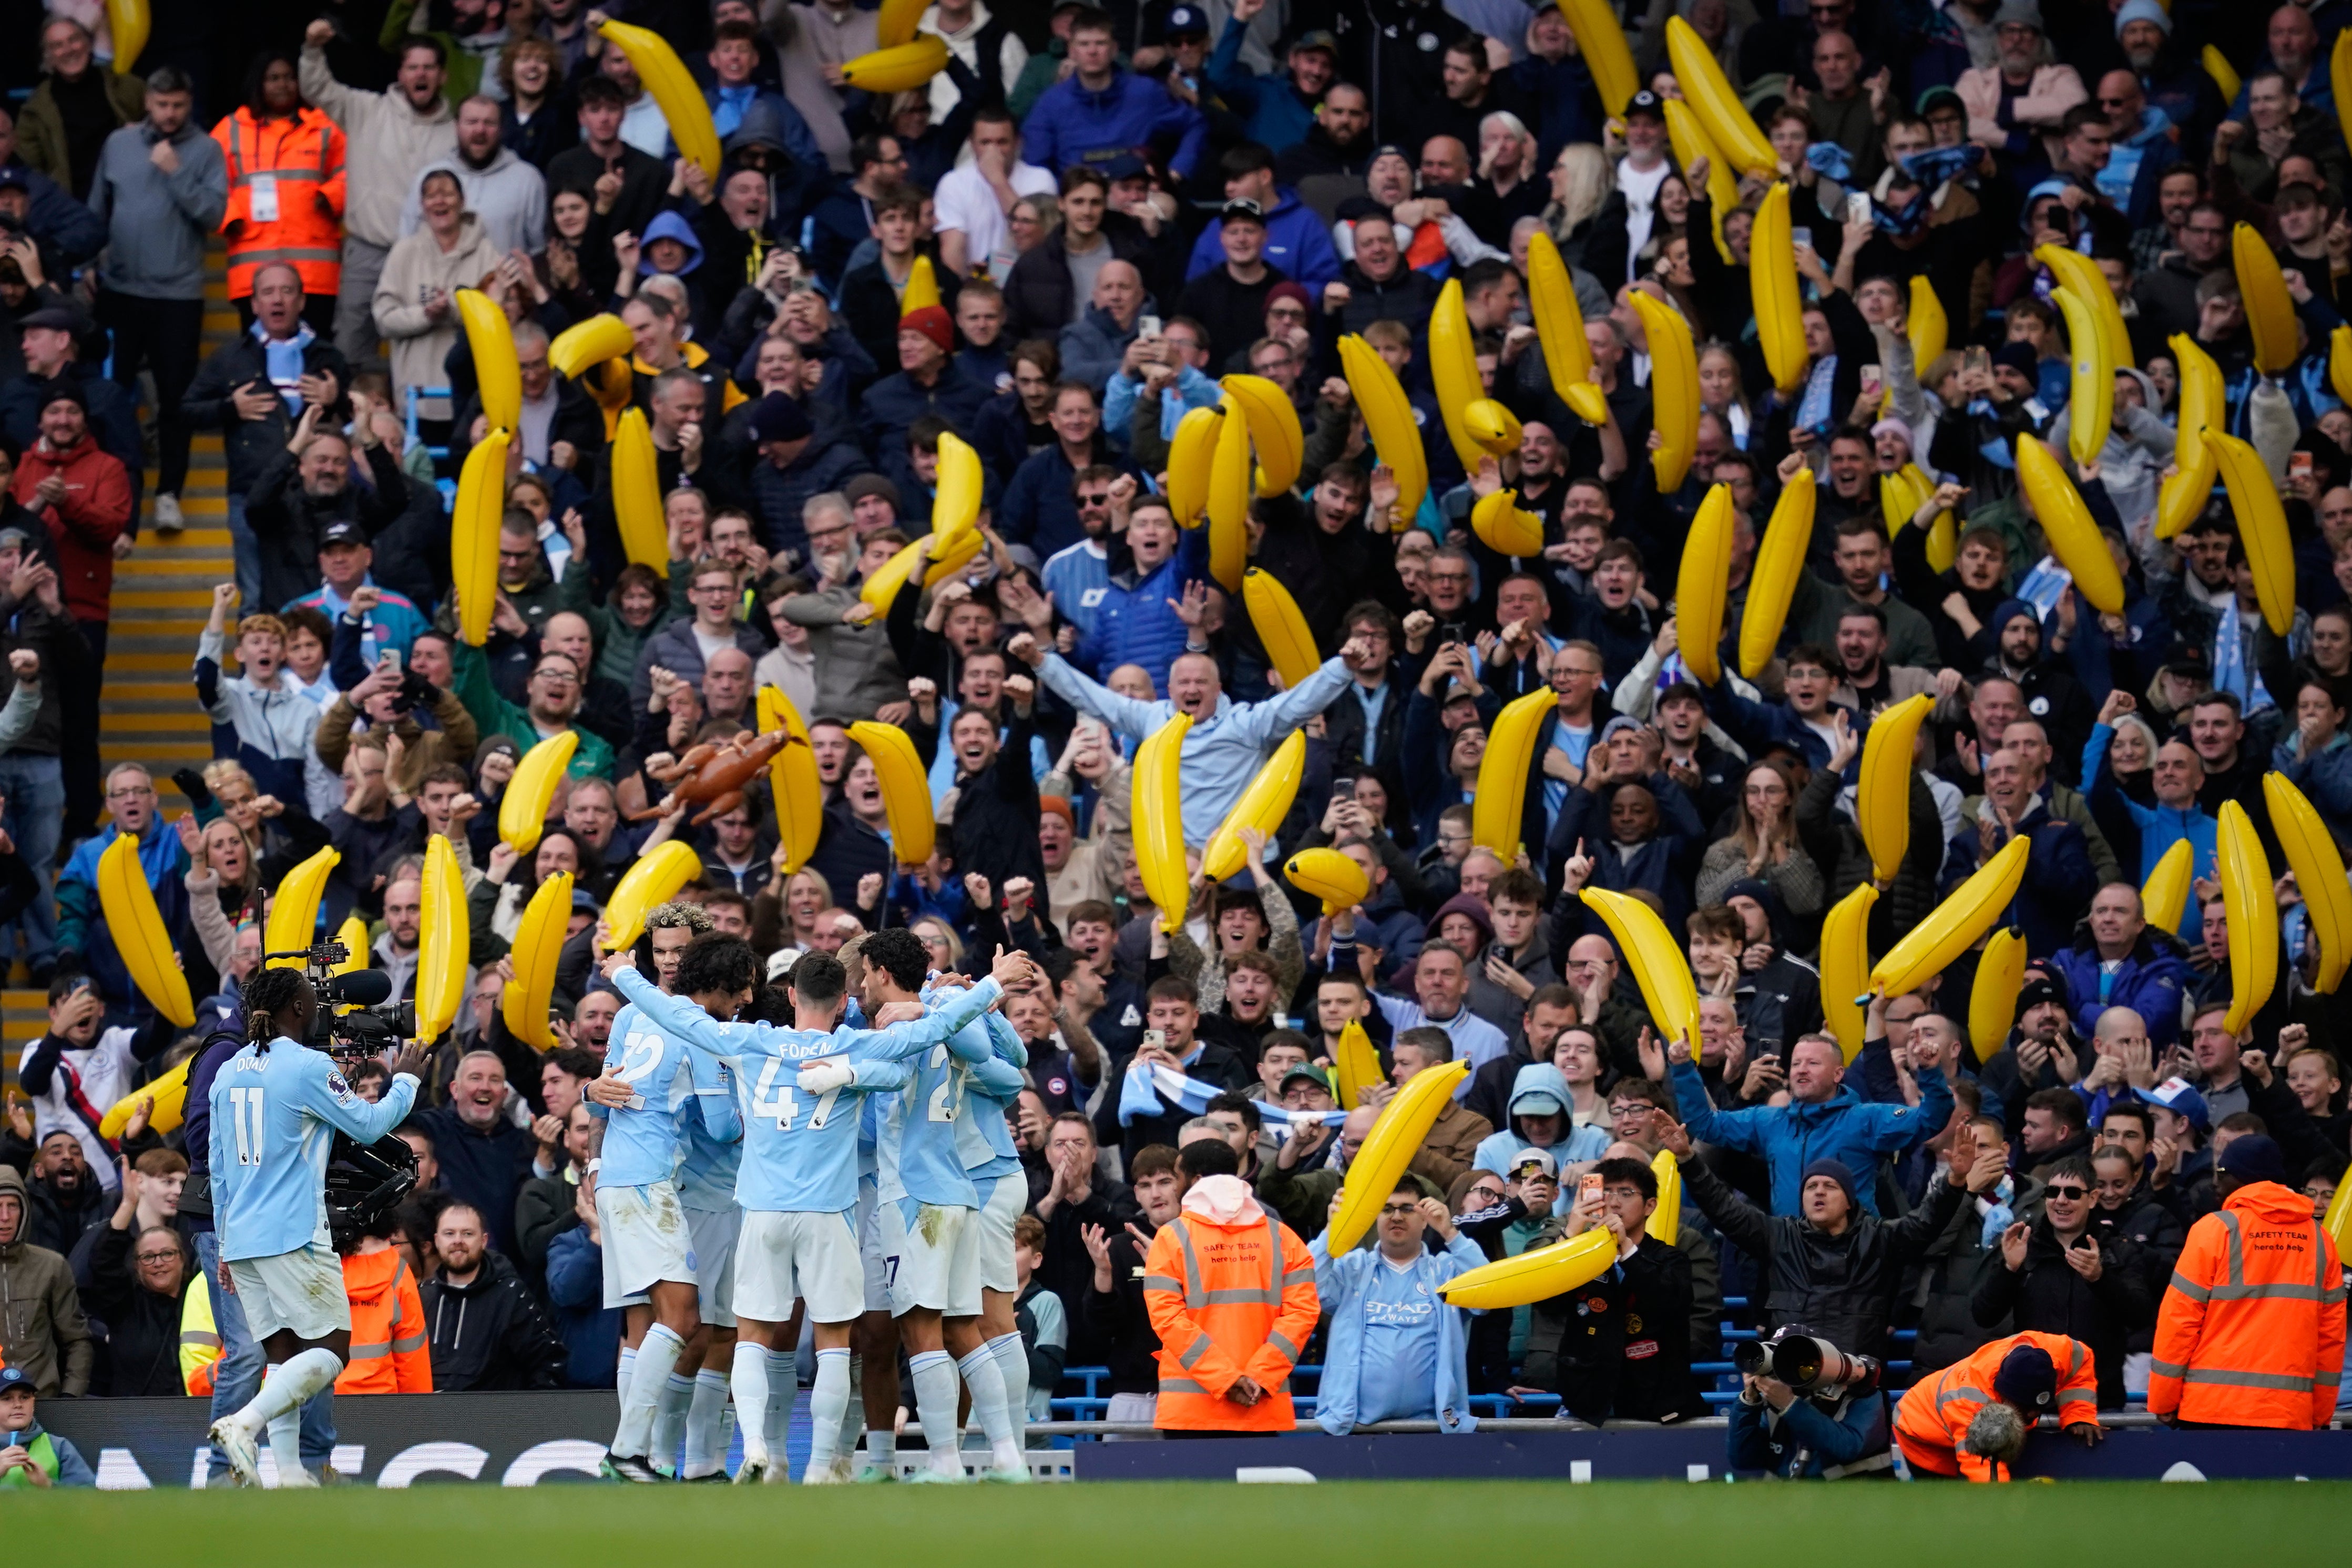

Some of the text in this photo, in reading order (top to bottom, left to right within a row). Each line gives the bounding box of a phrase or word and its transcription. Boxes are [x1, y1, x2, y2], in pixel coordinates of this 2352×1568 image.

[779, 1042, 832, 1058] FODEN
[752, 1053, 851, 1131] 47
[230, 1087, 264, 1166] 11
[2285, 1232, 2308, 1241] TEAM
[1203, 1243, 1233, 1252] SAFEY
[2287, 1244, 2304, 1253] help
